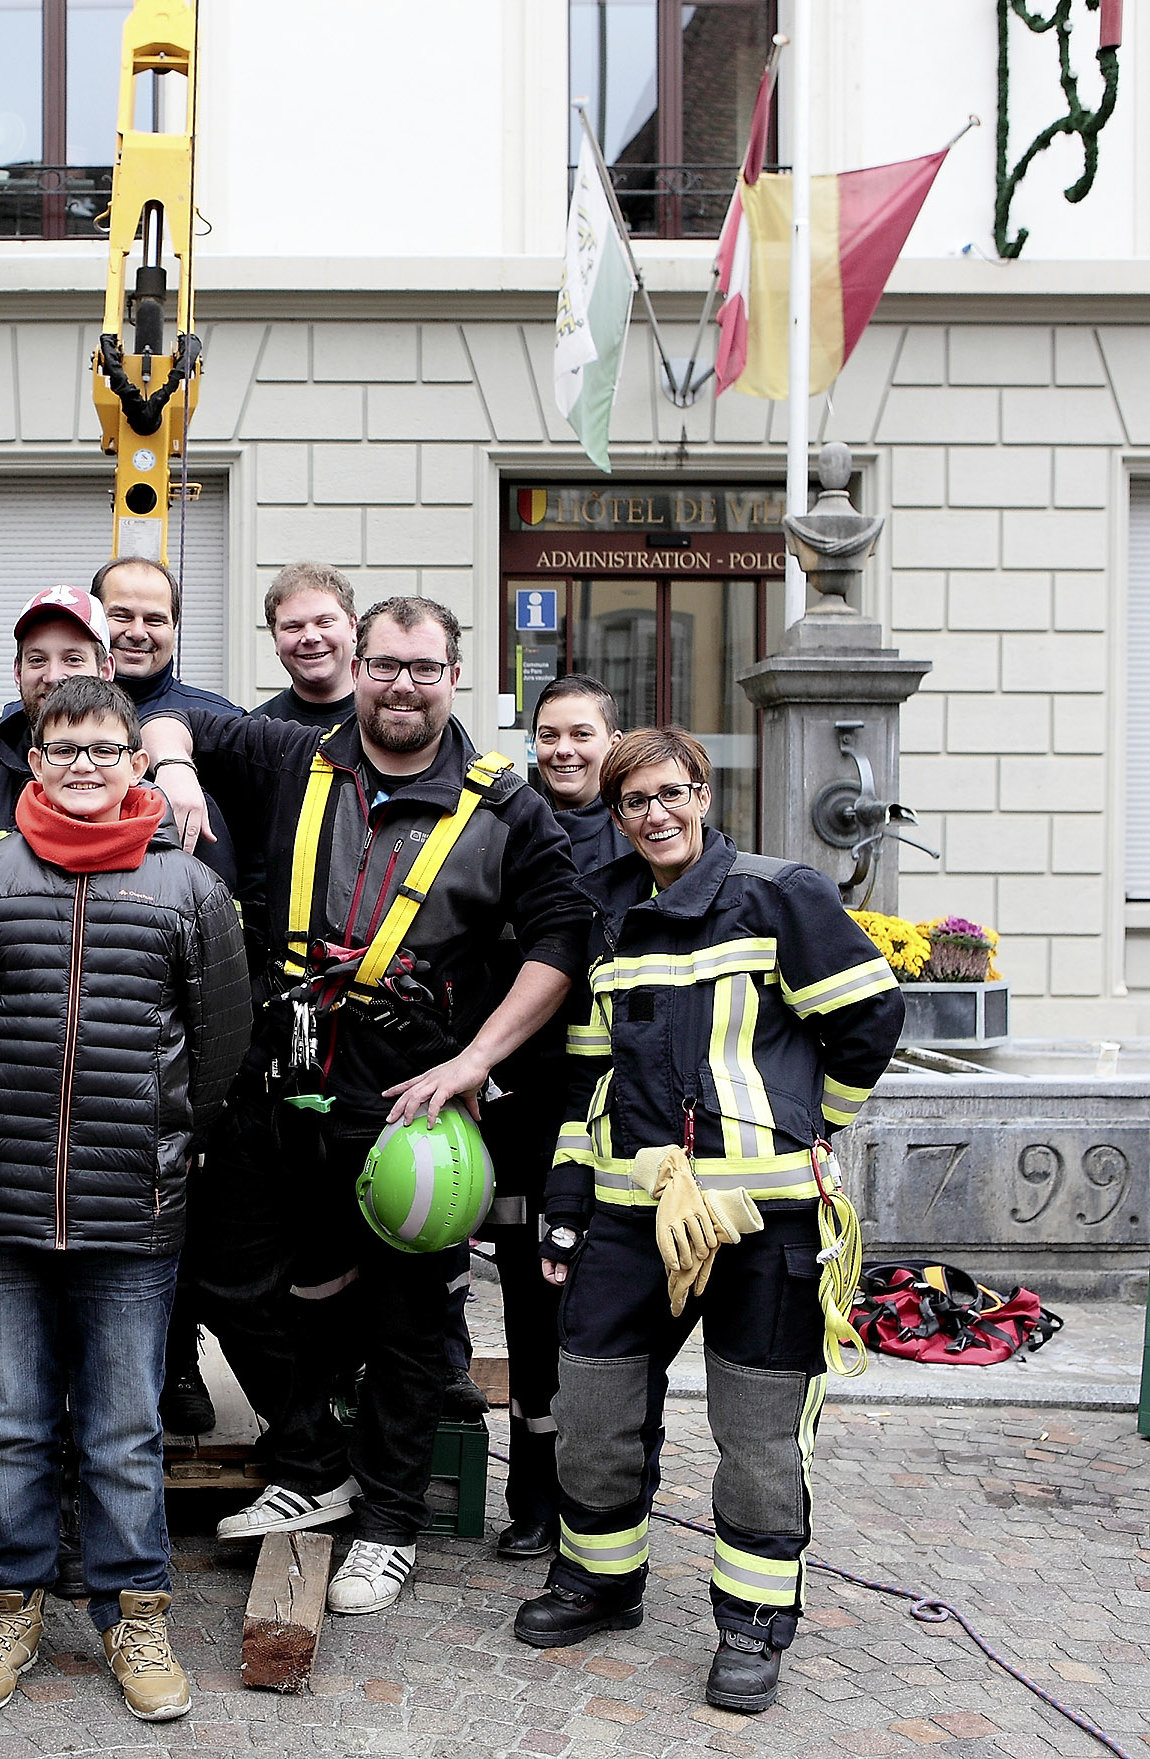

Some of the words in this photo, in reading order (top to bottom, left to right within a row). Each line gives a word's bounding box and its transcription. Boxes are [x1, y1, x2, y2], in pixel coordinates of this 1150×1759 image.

[554, 491, 665, 524] HÔTEL
[675, 497, 718, 525] DE
[536, 550, 711, 570] ADMINISTRATION
[729, 551, 786, 570] POLIC
